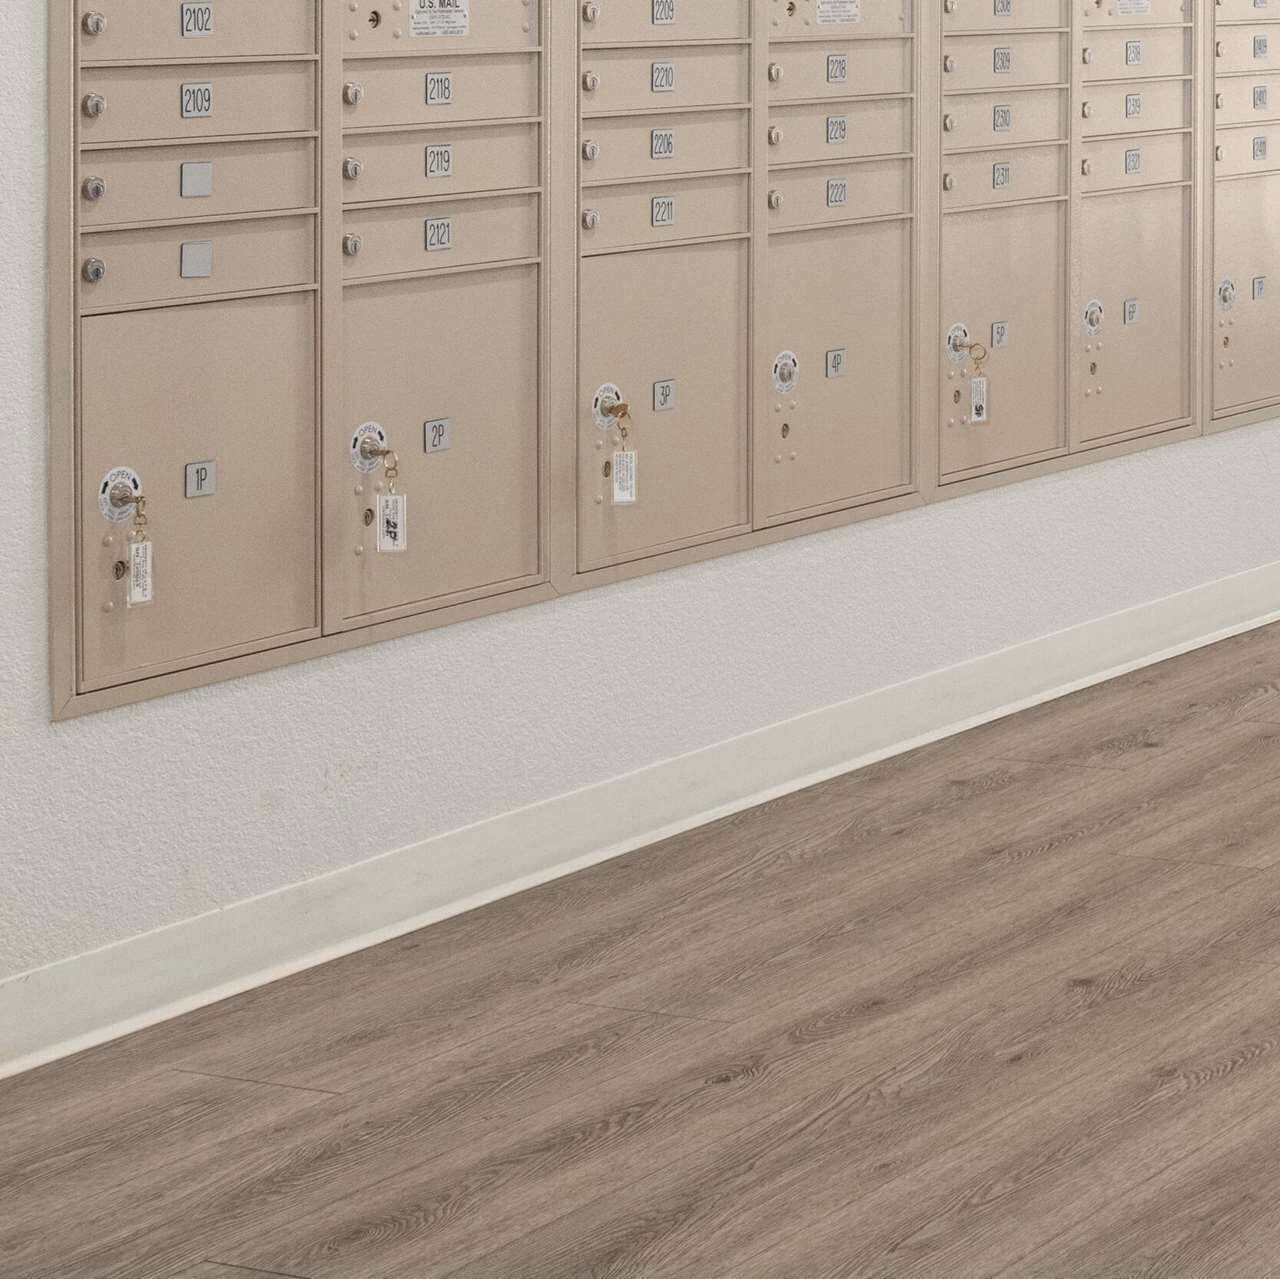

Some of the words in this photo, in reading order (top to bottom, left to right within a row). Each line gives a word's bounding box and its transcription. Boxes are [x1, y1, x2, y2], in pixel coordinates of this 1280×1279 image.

[184, 7, 211, 32] 2102
[655, 0, 674, 20] 2209
[830, 59, 846, 79] 2218
[995, 51, 1011, 70] 2309
[654, 66, 674, 87] 2210
[428, 77, 451, 100] 2118
[184, 88, 211, 114] 2109
[995, 109, 1010, 127] 2310
[830, 120, 846, 141] 2219
[654, 133, 673, 154] 2206
[428, 149, 450, 174] 2119
[995, 167, 1010, 186] 2311
[830, 183, 846, 204] 2221
[655, 201, 673, 222] 2211
[428, 222, 450, 247] 2121
[831, 354, 842, 373] 4P
[659, 385, 671, 406] 3P
[359, 424, 377, 436] OPEN
[431, 424, 445, 448] 2P
[195, 466, 208, 492] 1P
